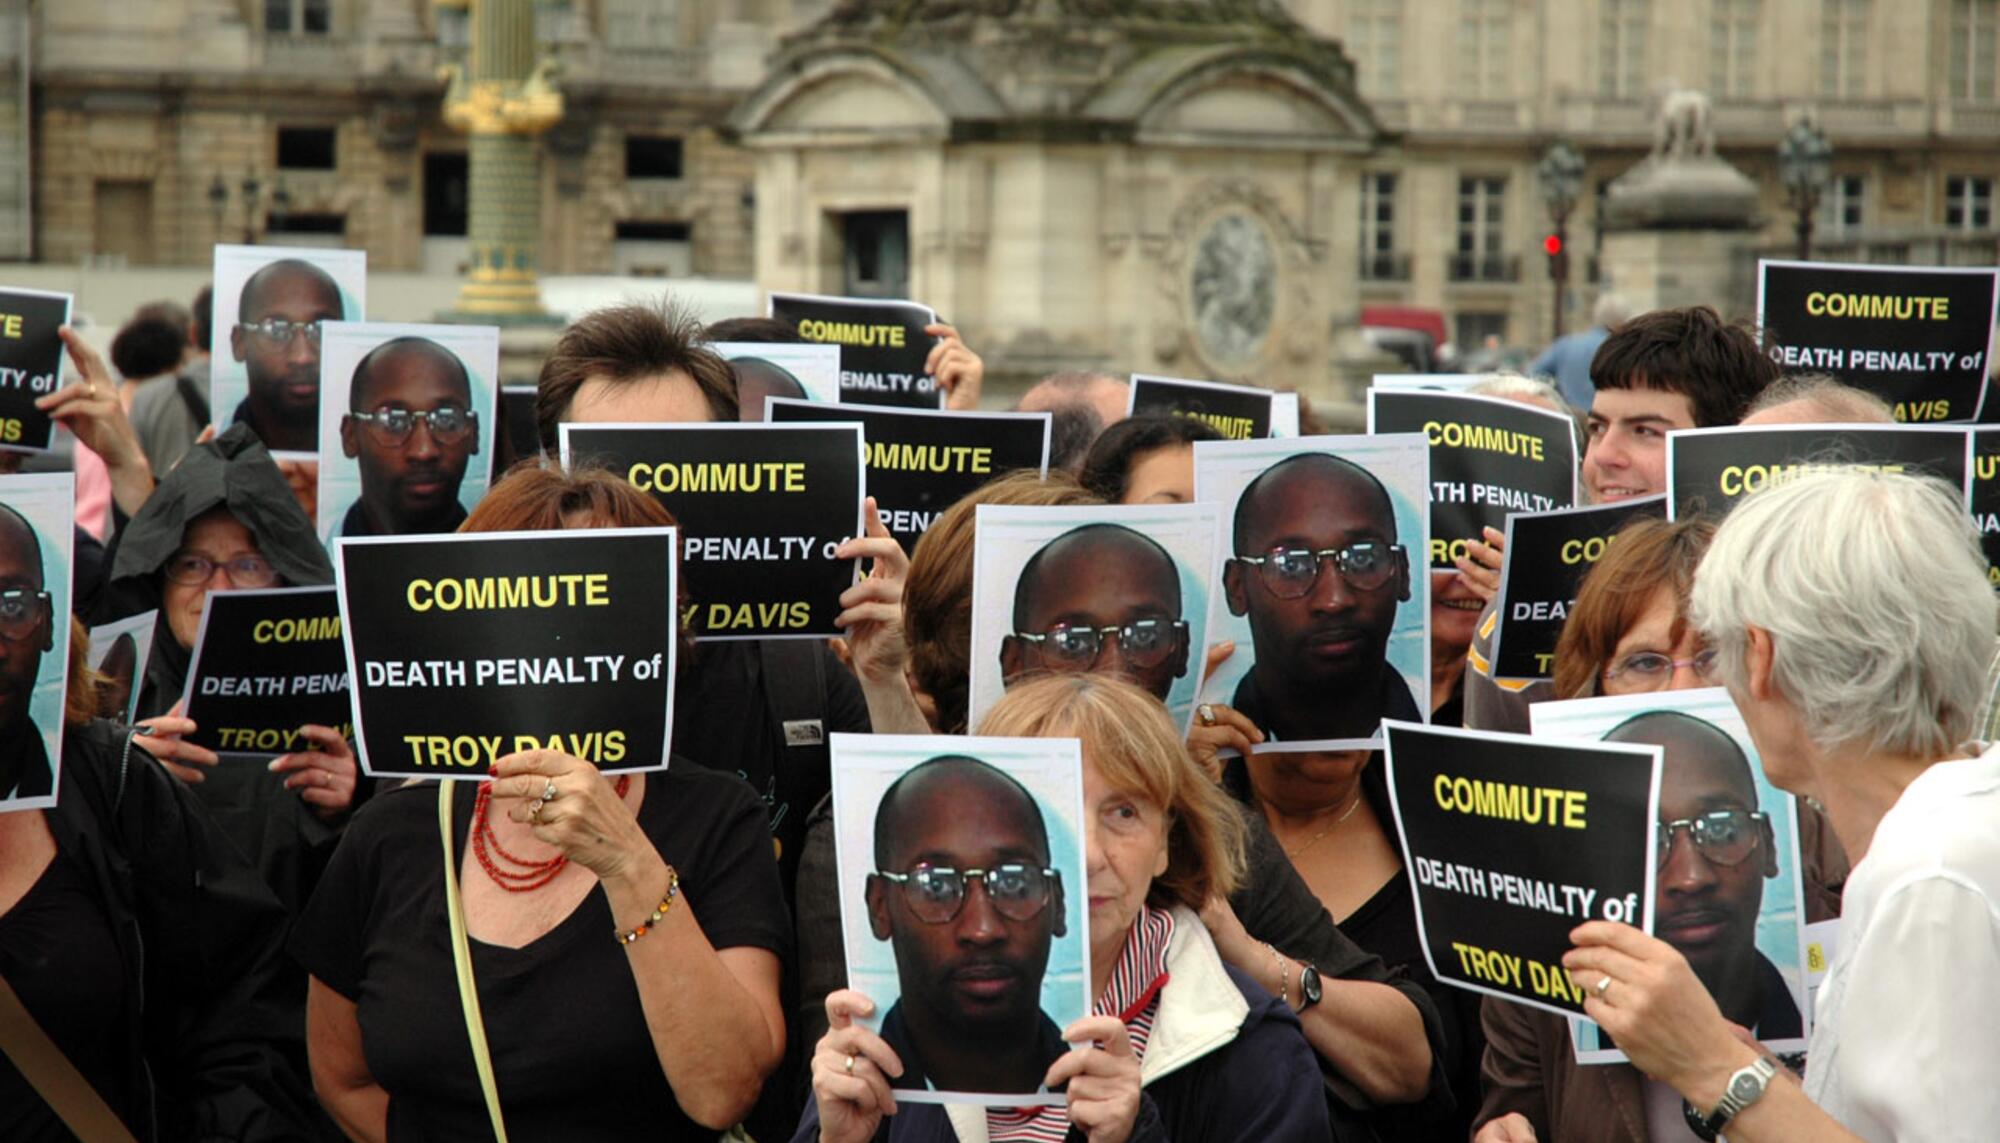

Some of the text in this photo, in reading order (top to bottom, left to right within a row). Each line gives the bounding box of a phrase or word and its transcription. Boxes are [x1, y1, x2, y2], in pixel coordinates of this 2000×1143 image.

[1806, 291, 1950, 321] COMMUTE
[799, 319, 906, 347] COMMUTE
[1850, 350, 1956, 372] PENALTY
[1960, 351, 1984, 370] of
[30, 373, 54, 392] of
[841, 371, 913, 392] ENALTY
[1893, 400, 1950, 422] AVIS
[1423, 421, 1545, 462] COMMUTE
[628, 463, 807, 493] COMMUTE
[1472, 483, 1554, 512] PENALTY
[684, 536, 816, 562] PENALTY
[407, 574, 611, 612] COMMUTE
[253, 616, 341, 644] COMM
[707, 602, 811, 630] DAVIS
[201, 672, 350, 697] DEATH PENA
[365, 653, 663, 688] DEATH PENALTY of
[217, 728, 300, 750] TROY
[404, 735, 502, 768] TROY
[1434, 774, 1588, 830] COMMUTE
[1415, 855, 1638, 924] DEATH PENALTY of
[1452, 941, 1523, 990] TROY
